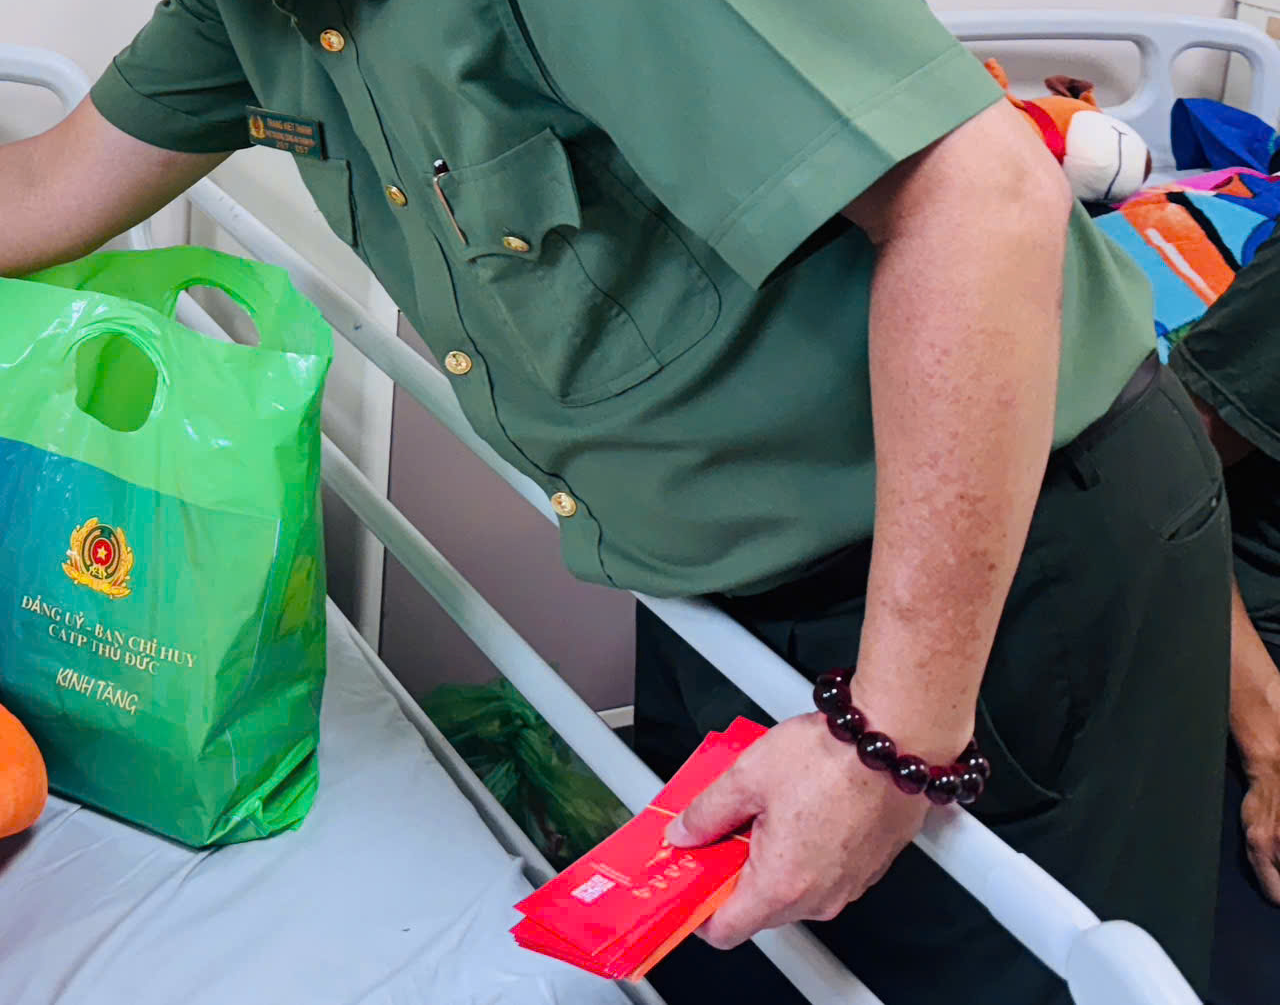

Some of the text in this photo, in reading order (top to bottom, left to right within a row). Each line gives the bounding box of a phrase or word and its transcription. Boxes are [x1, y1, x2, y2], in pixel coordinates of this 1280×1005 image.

[21, 595, 62, 621] ĐẢNG
[65, 611, 84, 629] UỶ
[95, 624, 125, 645] BAN
[128, 636, 158, 656] CHỈ
[160, 646, 197, 667] HUY
[48, 624, 160, 675] CATP THỦ ĐỨC
[97, 680, 139, 716] TẶNG
